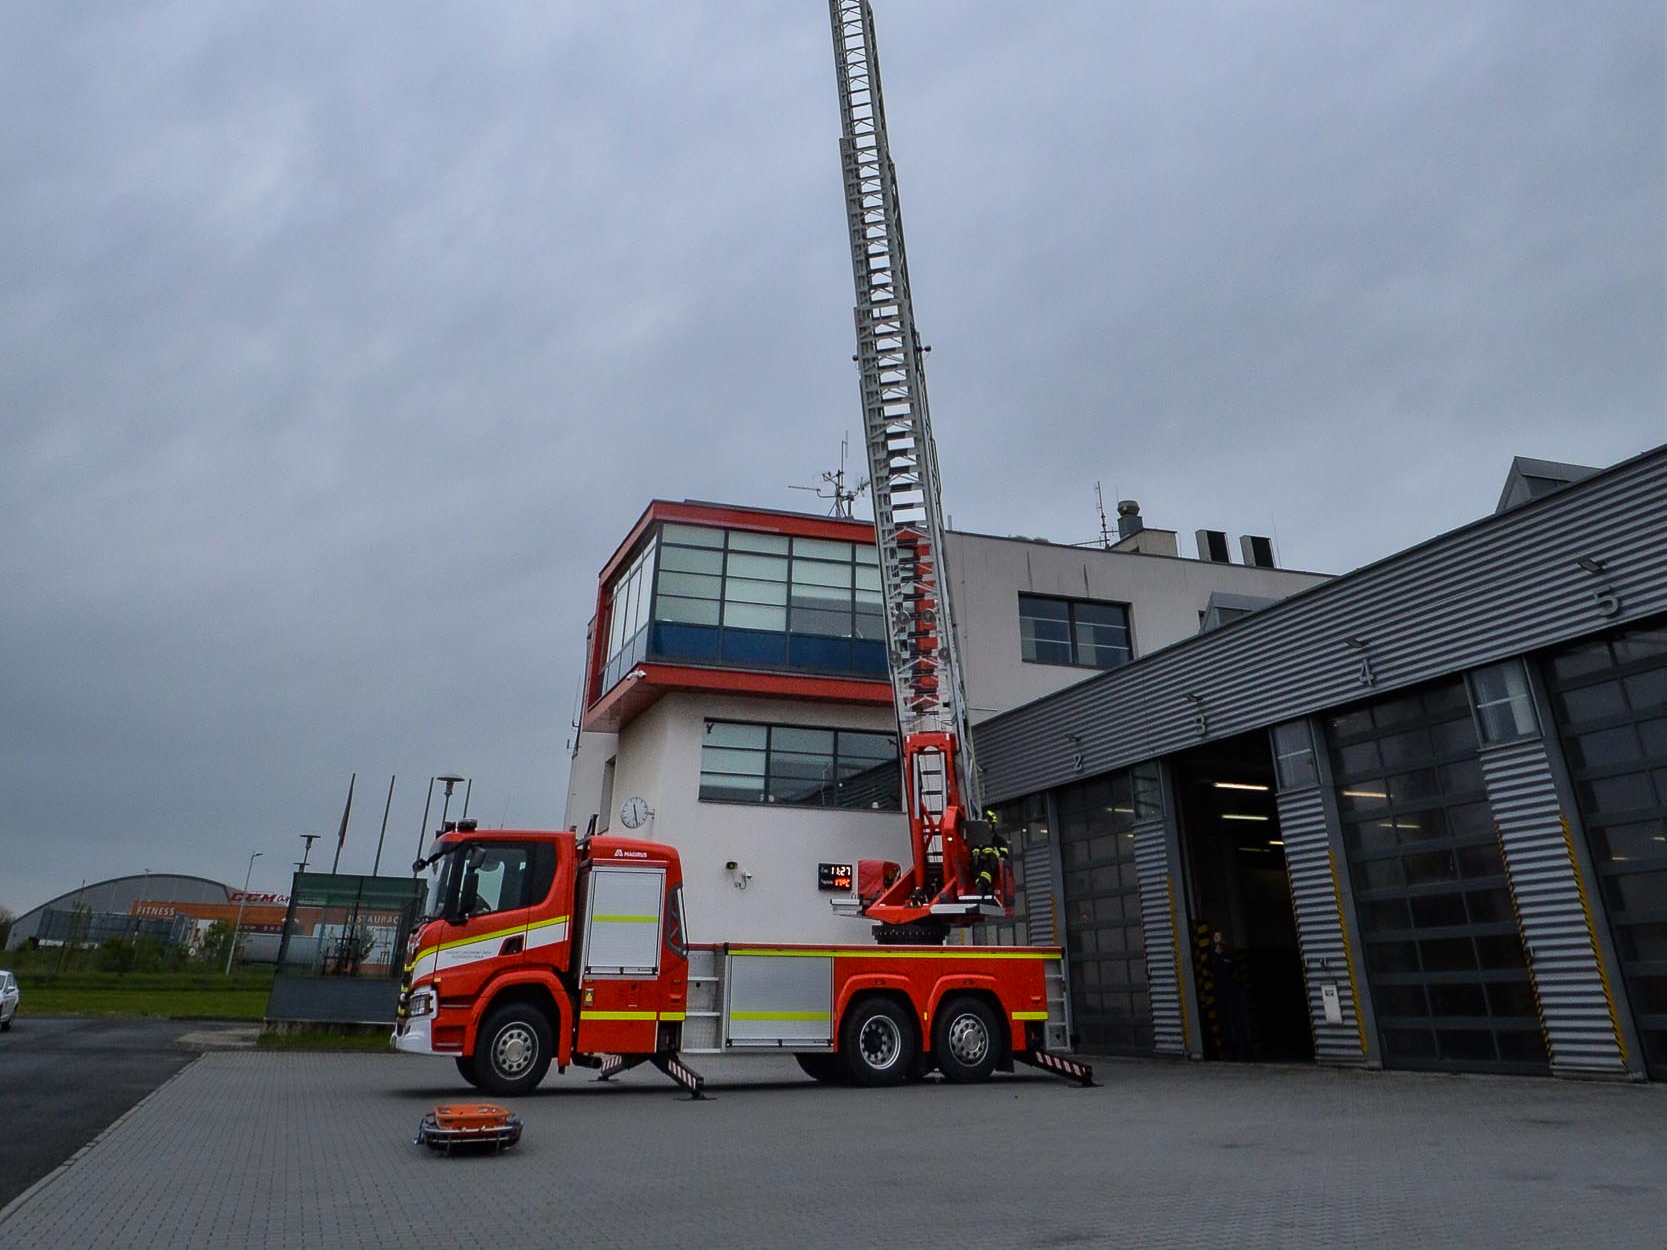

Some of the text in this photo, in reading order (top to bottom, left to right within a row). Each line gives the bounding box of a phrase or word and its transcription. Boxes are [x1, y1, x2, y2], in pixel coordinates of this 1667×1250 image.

[1592, 584, 1619, 617] 5
[1359, 658, 1374, 687] 4
[1194, 713, 1206, 735] 3
[1072, 753, 1083, 771] 2
[831, 866, 851, 876] 11:27
[136, 906, 175, 916] FITNESS
